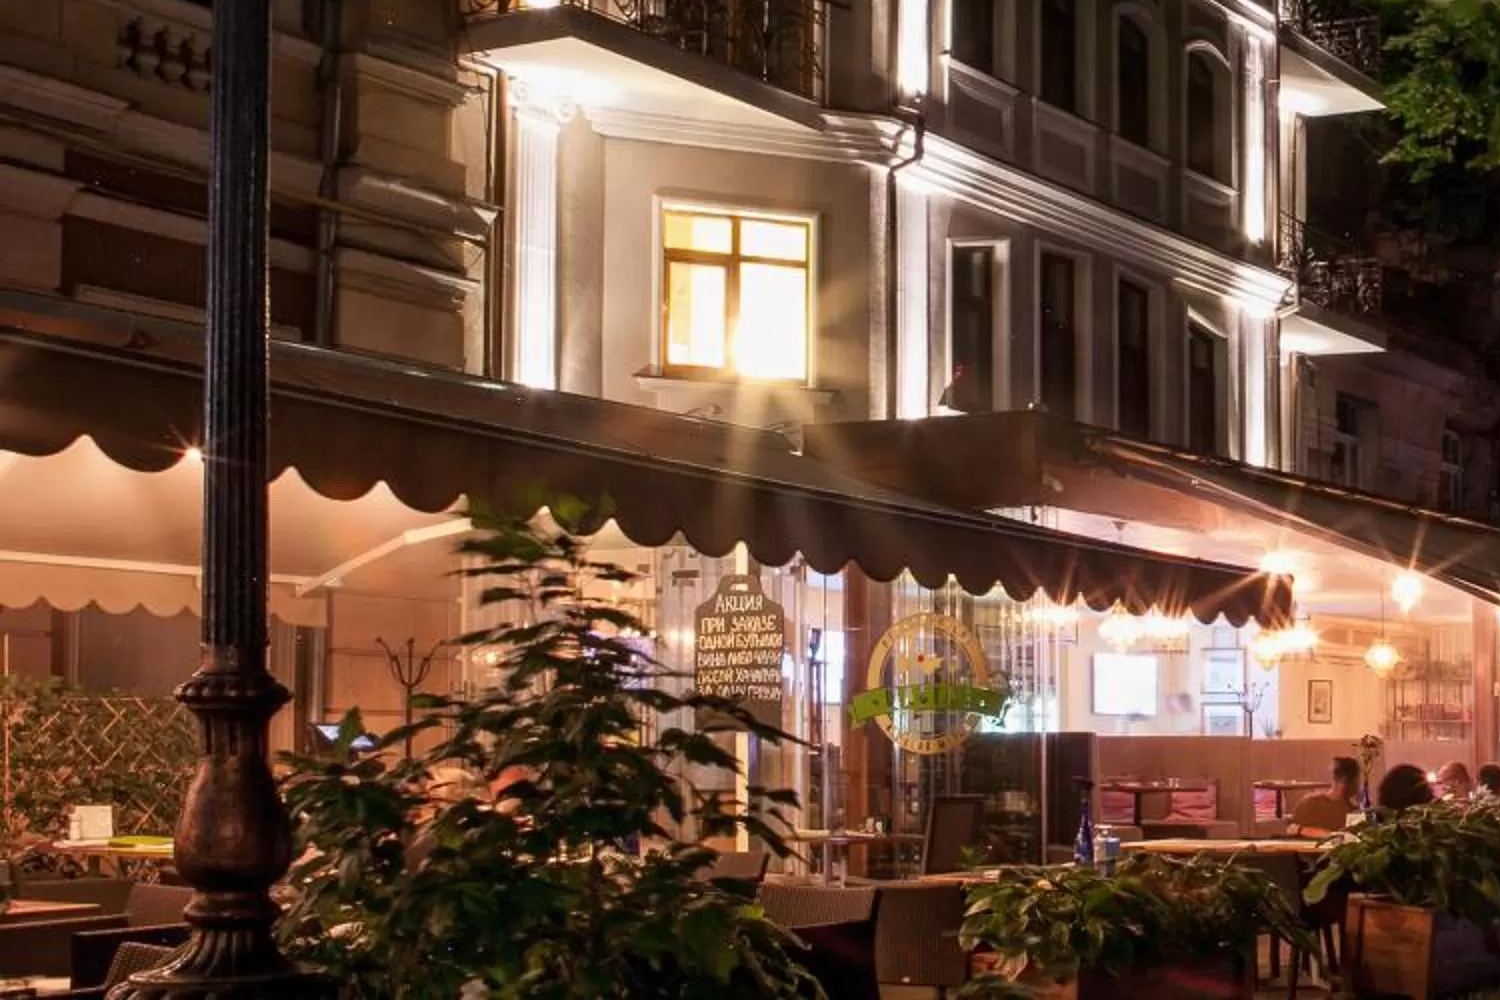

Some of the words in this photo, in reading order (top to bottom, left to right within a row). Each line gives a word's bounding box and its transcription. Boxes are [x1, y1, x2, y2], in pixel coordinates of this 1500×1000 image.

[715, 593, 763, 613] АКЦИЯ
[701, 617, 725, 633] ПРИ
[730, 615, 777, 632] ЗАКАЗЕ
[699, 632, 735, 650] ОДНОЙ
[736, 633, 782, 649] БУТЫЛКИ
